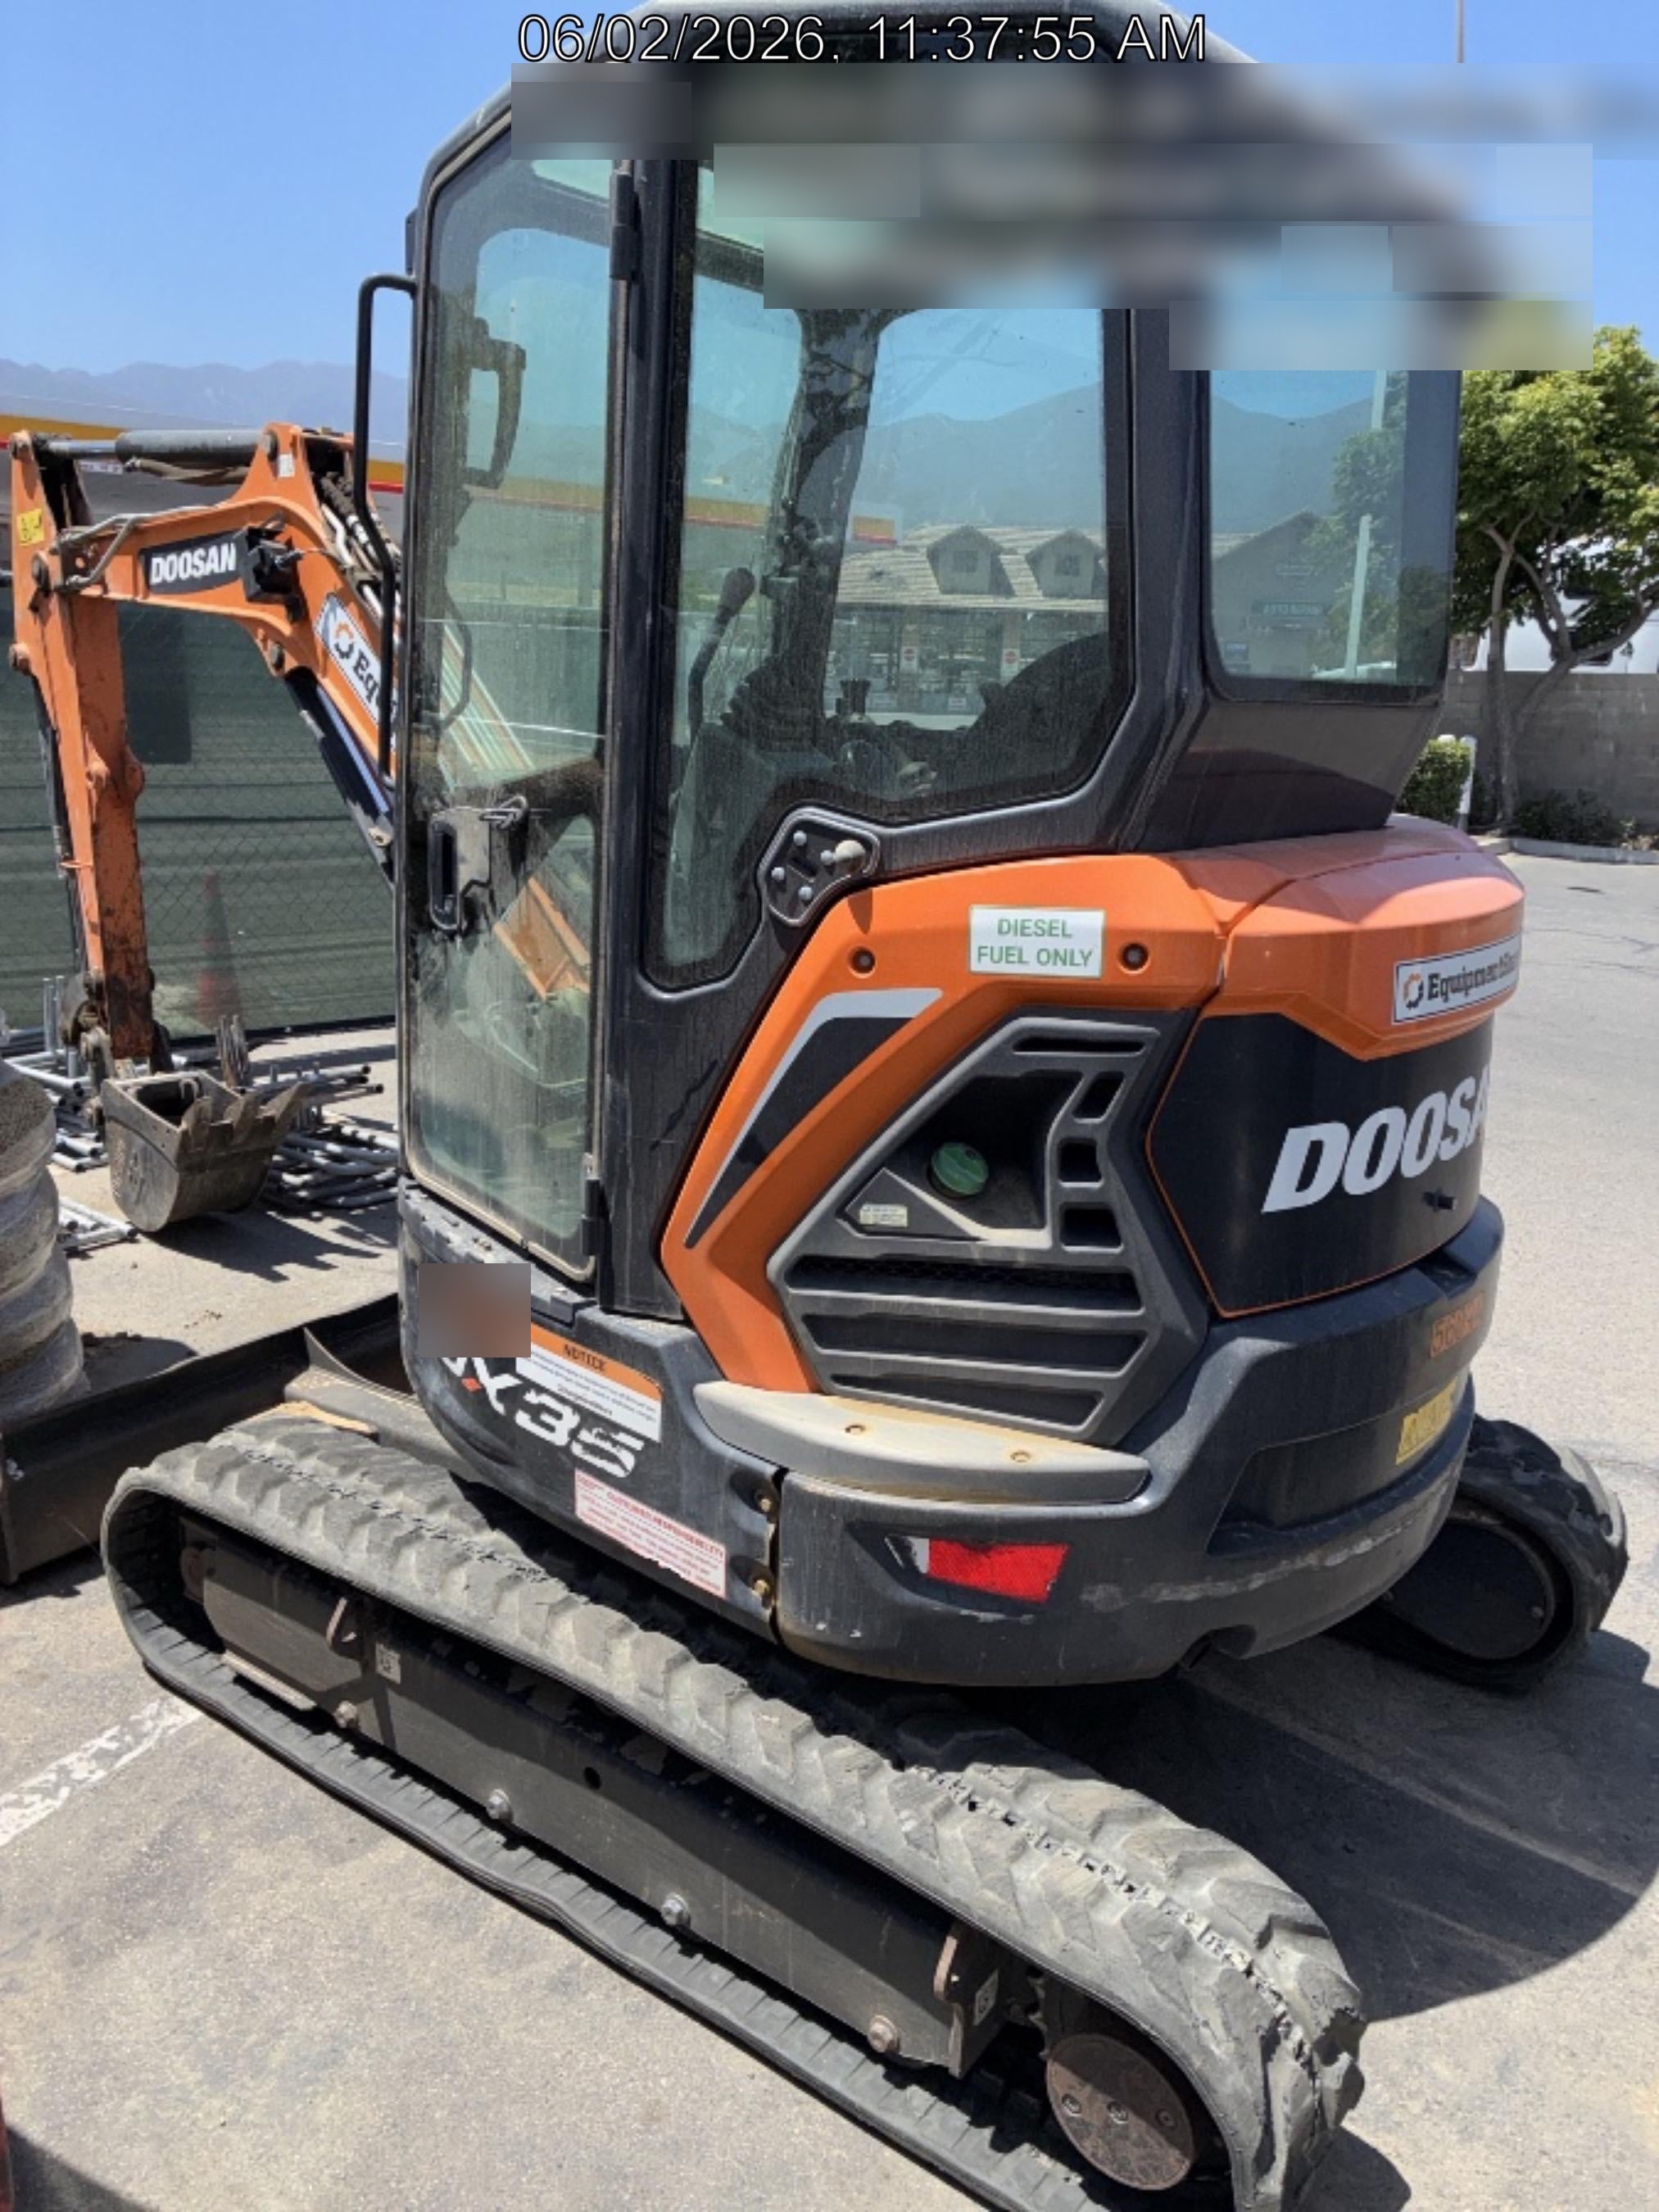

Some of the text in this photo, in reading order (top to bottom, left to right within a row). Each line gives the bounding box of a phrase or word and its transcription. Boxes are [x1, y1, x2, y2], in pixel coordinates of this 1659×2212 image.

[150, 542, 236, 584] DOOSAN
[997, 918, 1072, 939] DIESEL
[977, 945, 1093, 967] FUEL ONLY
